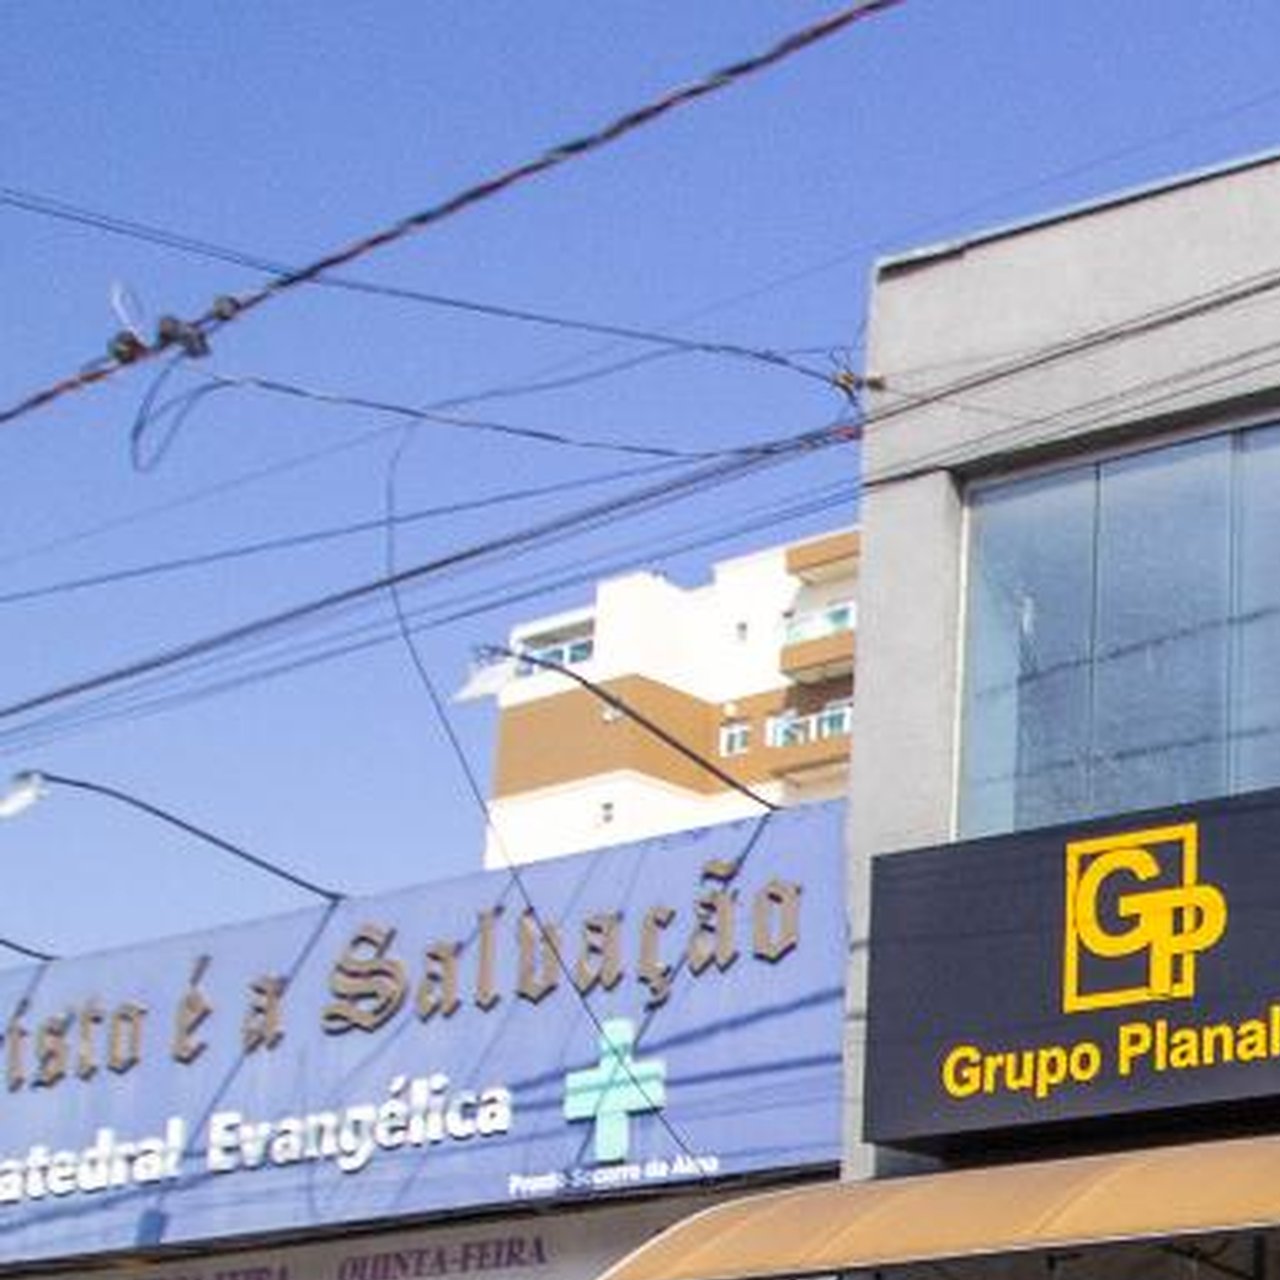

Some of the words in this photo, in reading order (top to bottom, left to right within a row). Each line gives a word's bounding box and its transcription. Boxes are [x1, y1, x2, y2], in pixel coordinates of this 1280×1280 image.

[321, 859, 803, 1036] Salvação
[942, 1037, 1101, 1098] Grupo
[207, 1071, 511, 1175] Evangélica
